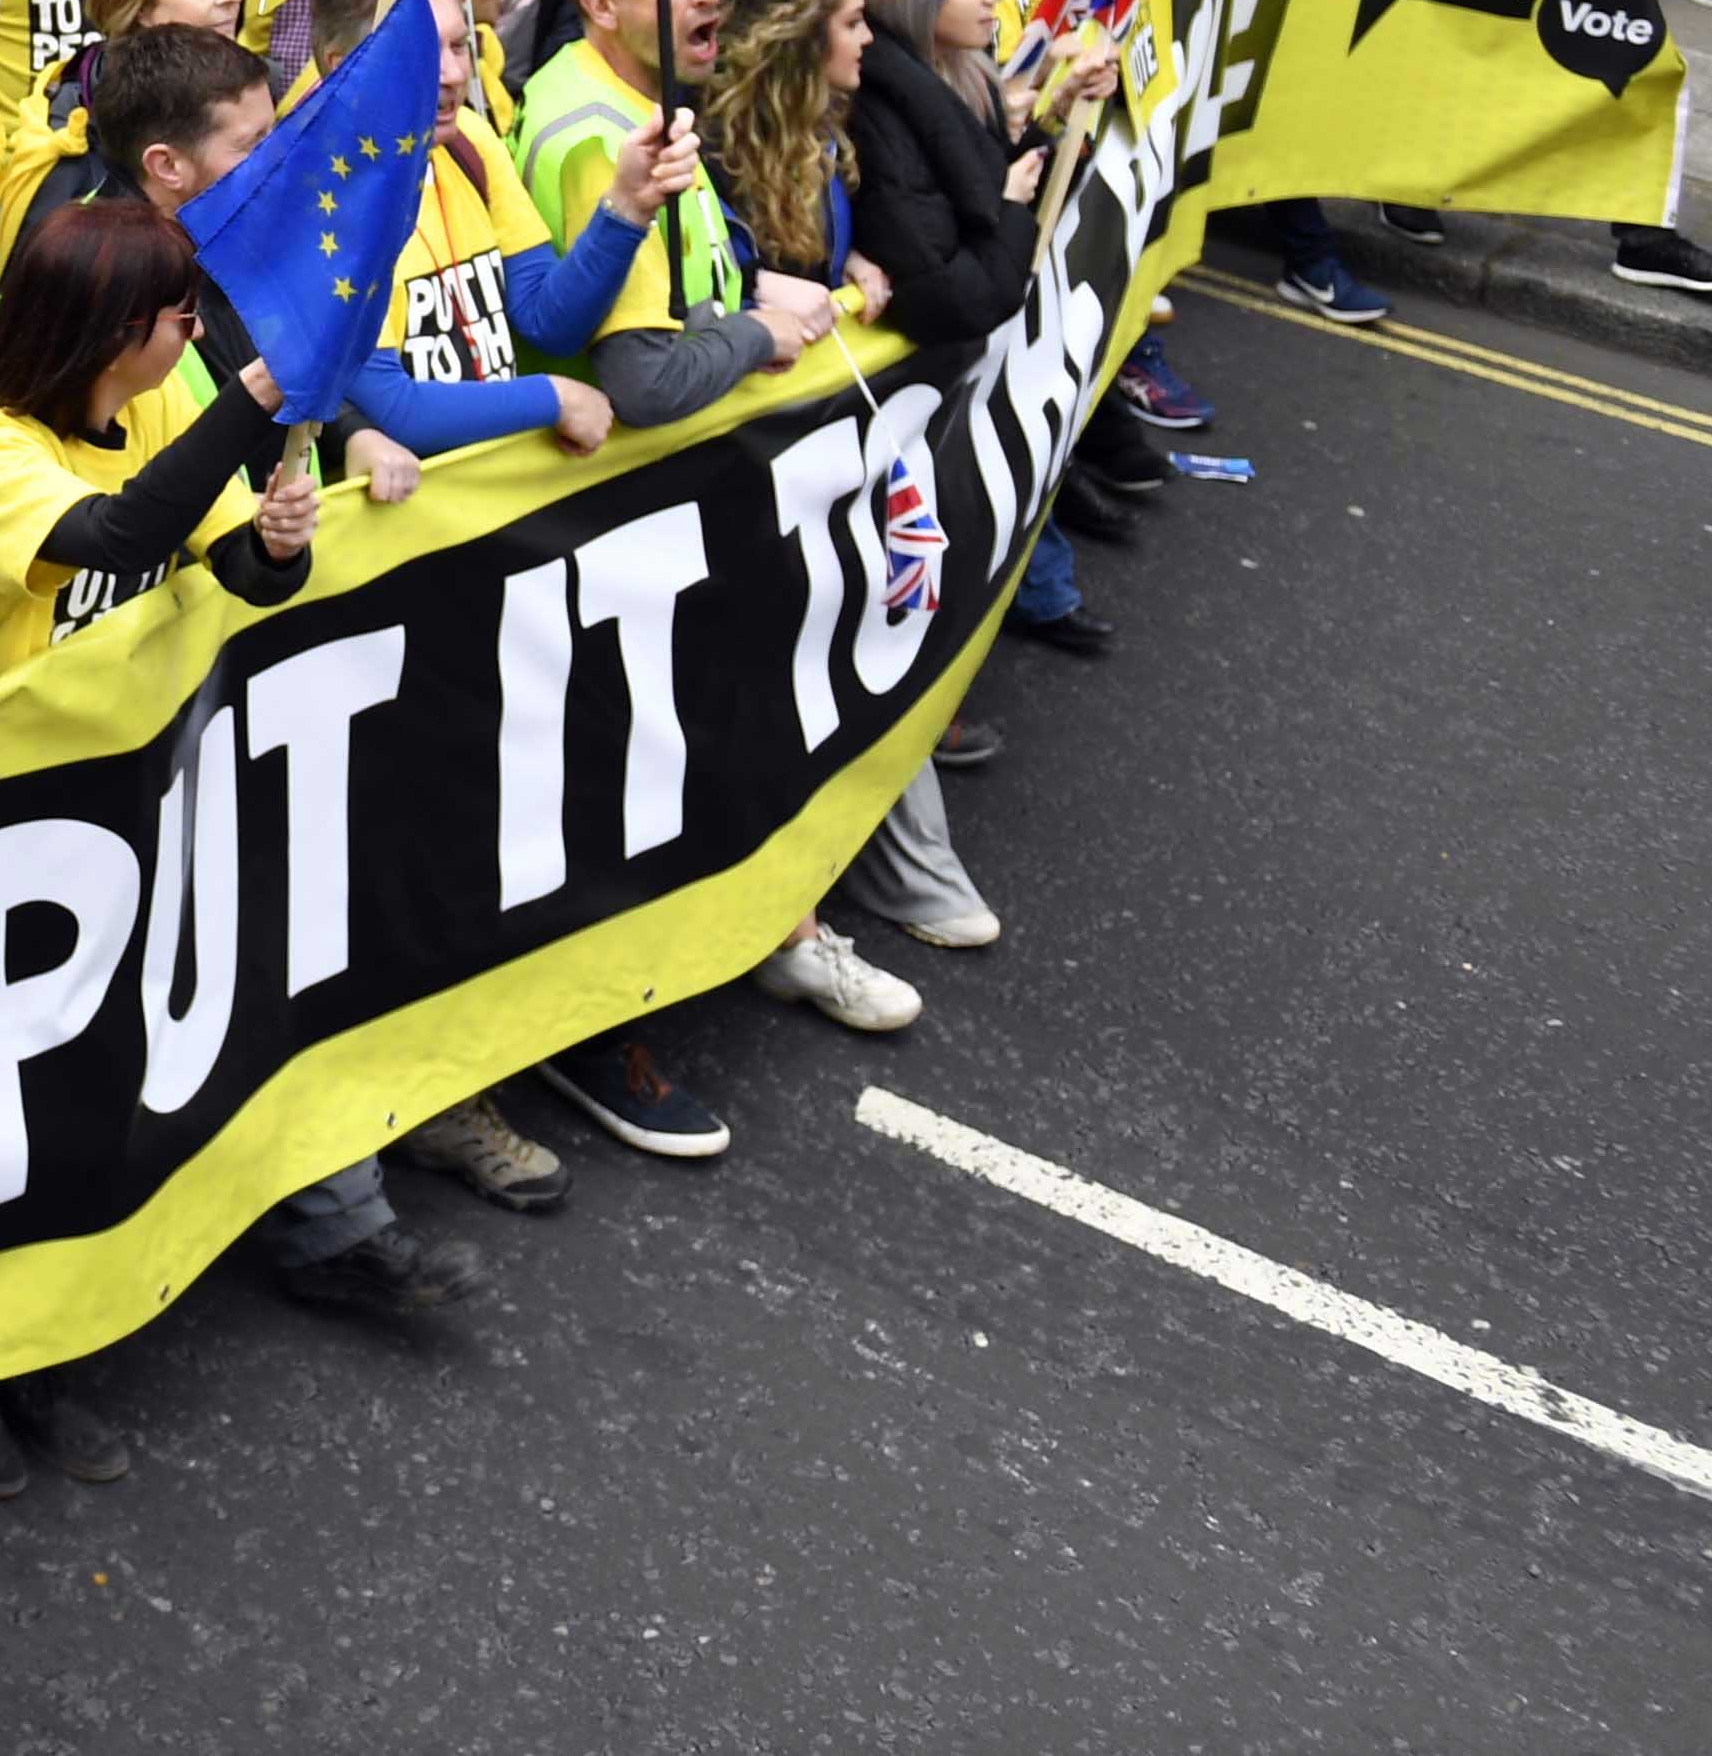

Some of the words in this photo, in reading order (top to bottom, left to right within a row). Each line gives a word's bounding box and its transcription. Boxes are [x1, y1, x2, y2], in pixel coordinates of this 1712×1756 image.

[1558, 0, 1654, 46] Vote
[495, 500, 713, 915] IT
[770, 382, 947, 756] TO
